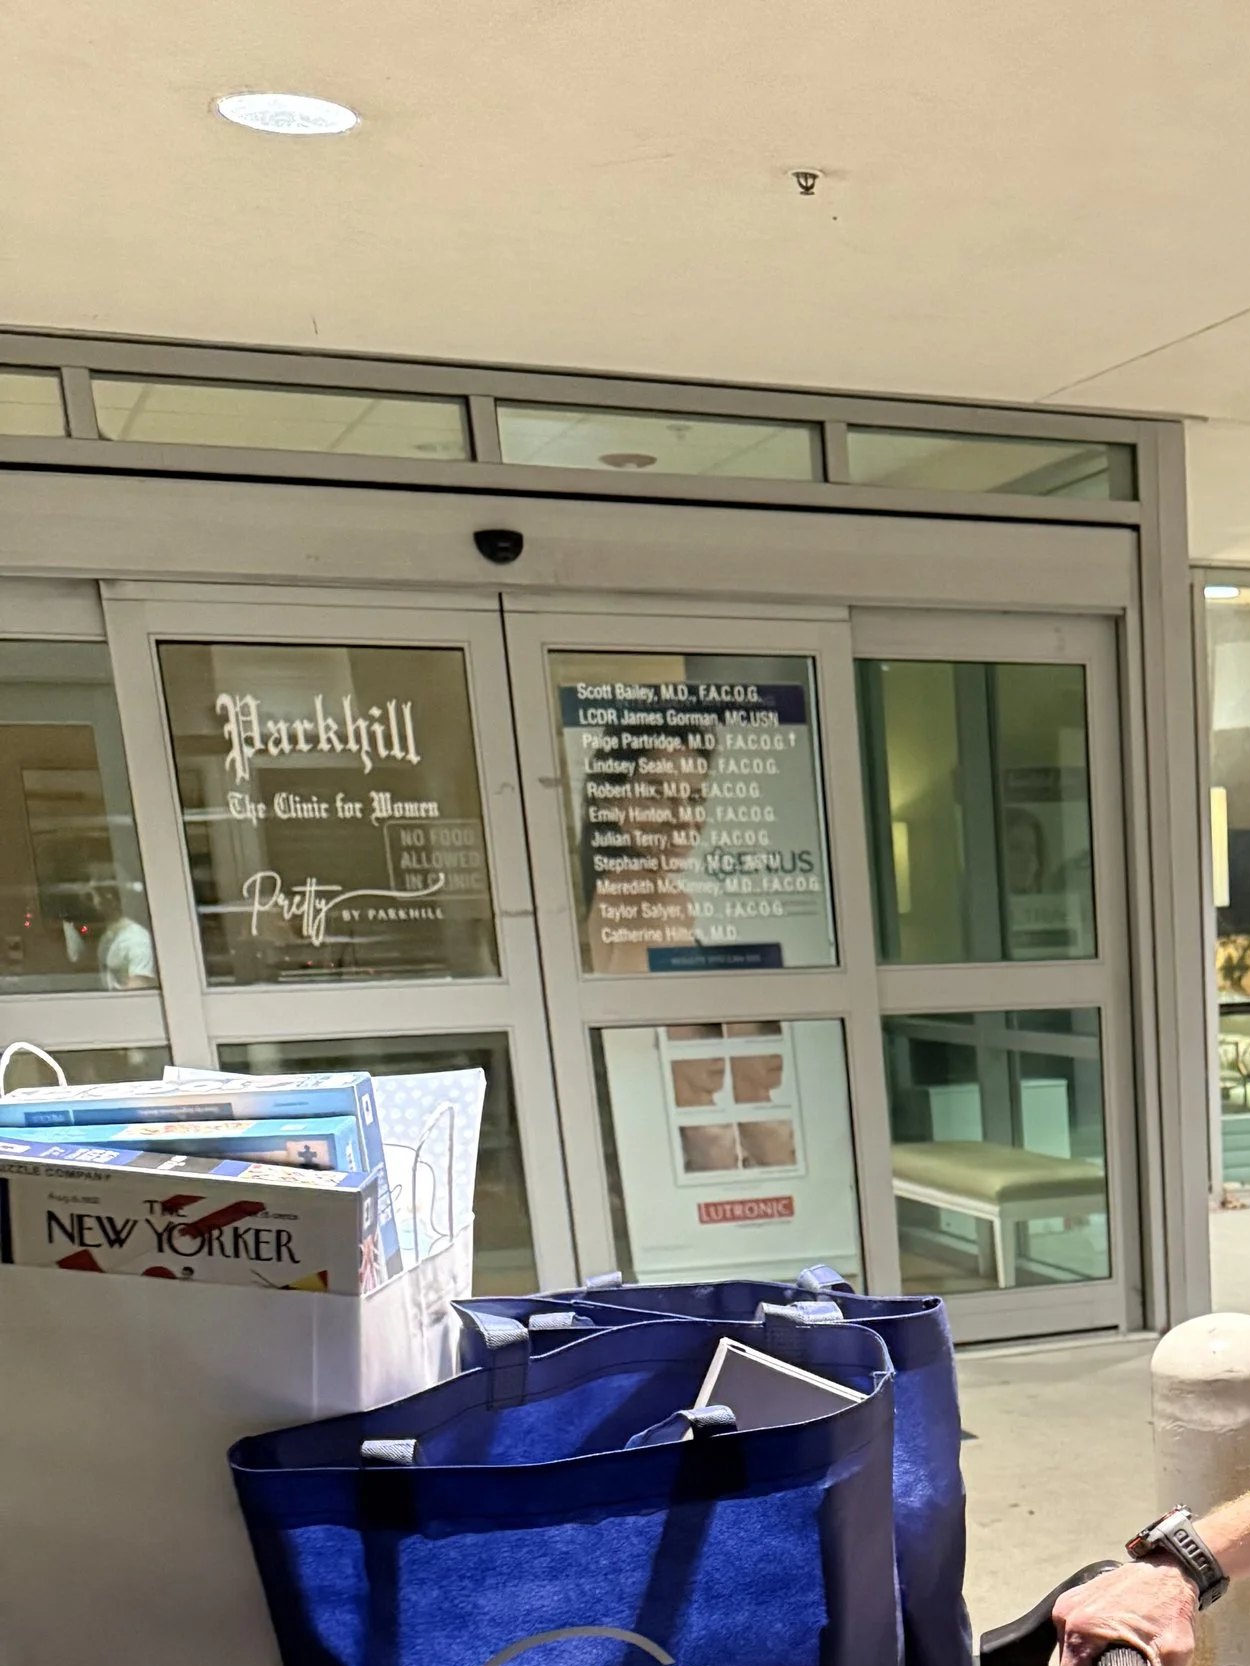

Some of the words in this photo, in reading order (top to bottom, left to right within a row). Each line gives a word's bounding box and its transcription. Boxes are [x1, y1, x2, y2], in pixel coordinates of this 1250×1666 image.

[577, 682, 613, 700] Scott
[615, 683, 659, 704] Bailey,
[579, 708, 619, 725] LCDR
[621, 709, 664, 726] James
[666, 709, 723, 729] Gorman,
[216, 694, 421, 785] Parkhill
[582, 732, 619, 753] Paige
[621, 732, 686, 753] Partridge,
[584, 757, 636, 777] Lindsey
[586, 781, 632, 798] Robert
[227, 791, 266, 826] The
[274, 792, 330, 819] Clinic
[336, 793, 364, 818] for
[369, 790, 440, 825] Women
[588, 806, 626, 826] Emily
[401, 829, 425, 846] NO
[591, 830, 632, 847] Julian
[632, 829, 670, 850] Terry,
[402, 851, 482, 869] ALLOWED
[593, 853, 659, 874] Stephanie
[405, 872, 424, 890] IN
[596, 878, 655, 896] Meredith
[341, 908, 360, 921] BY
[367, 905, 445, 920] PARKHILL
[599, 901, 638, 922] Taylor
[601, 926, 663, 944] Catherine
[44, 1167, 112, 1182] COMPANY
[700, 1200, 790, 1219] LUTRONIC
[46, 1210, 139, 1249] NEW
[145, 1218, 301, 1264] YORKER
